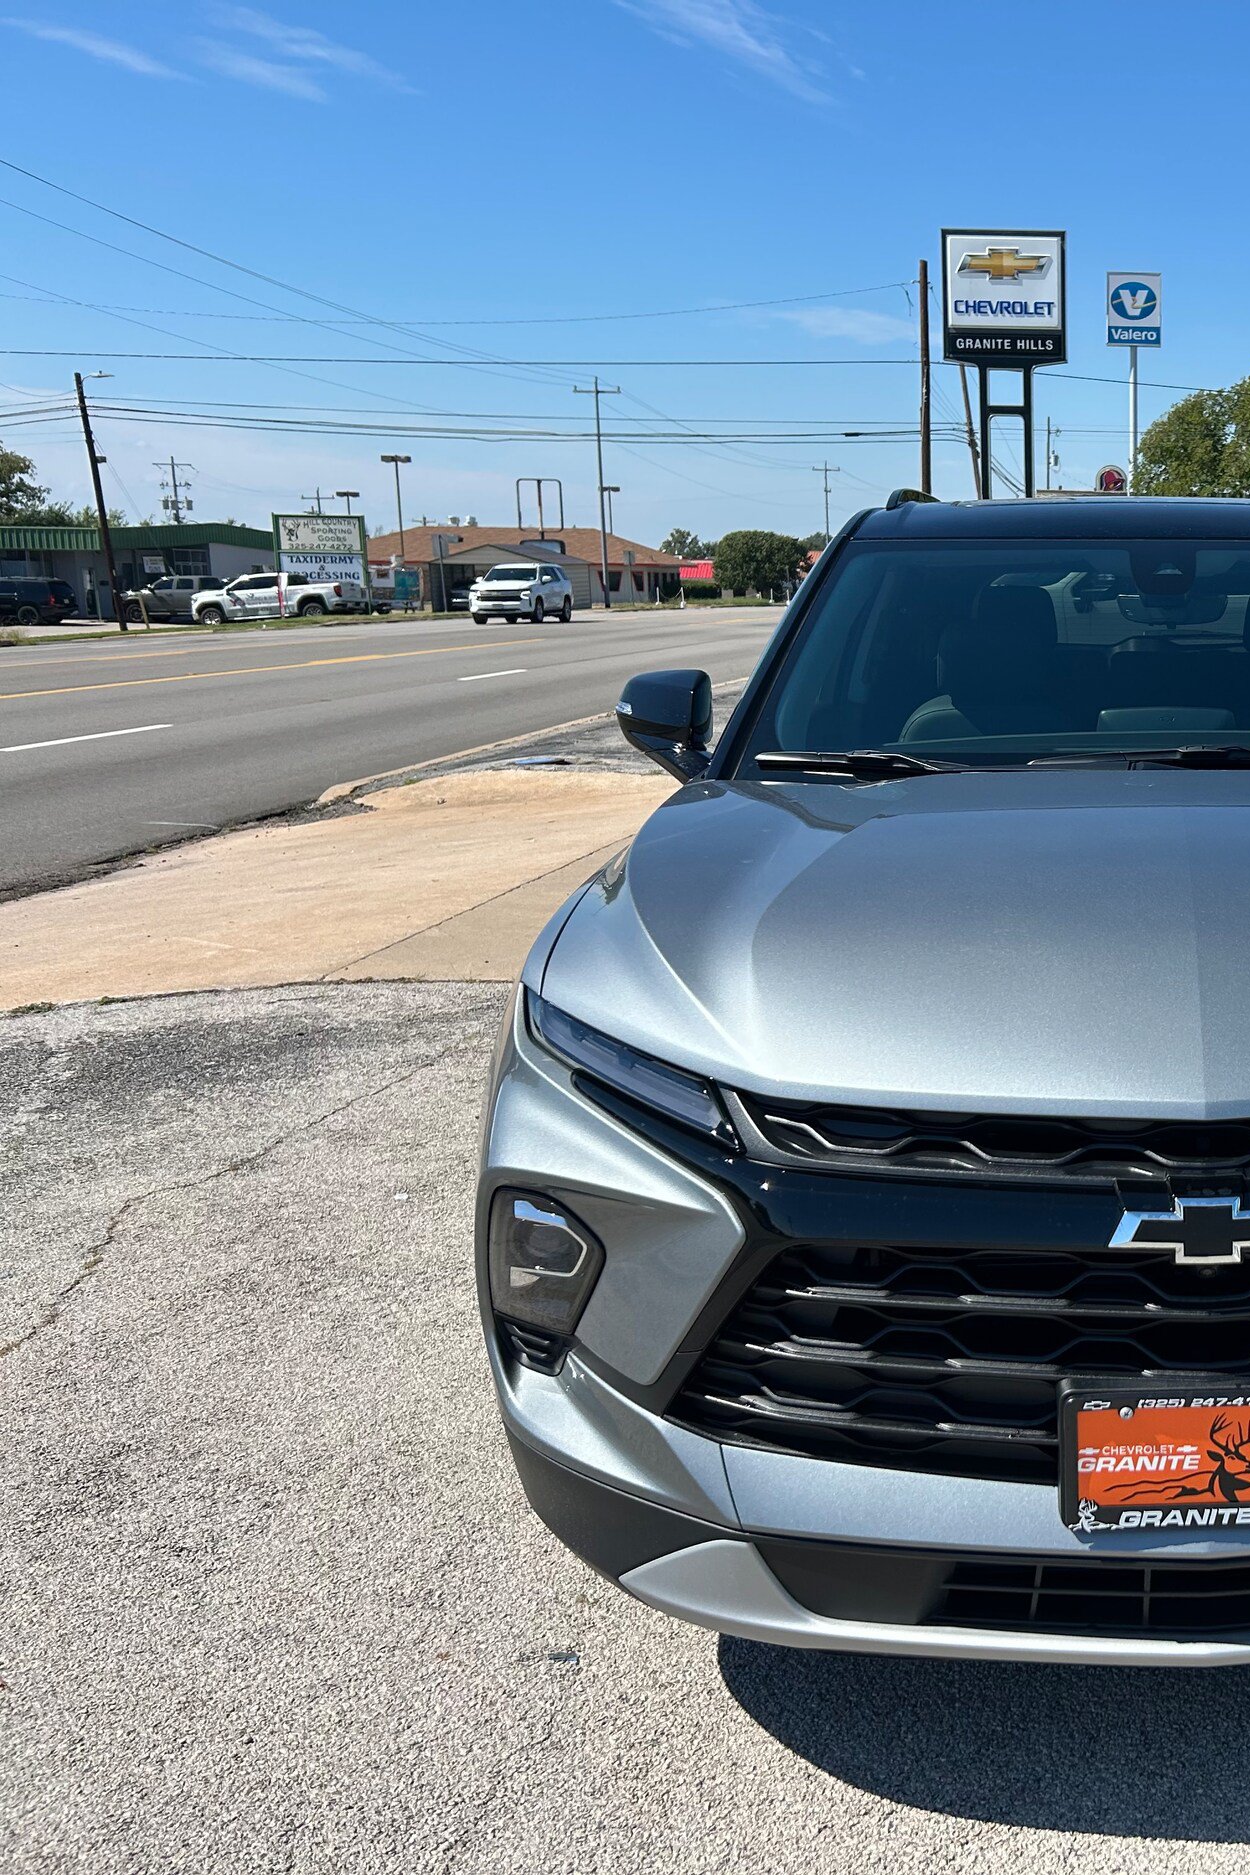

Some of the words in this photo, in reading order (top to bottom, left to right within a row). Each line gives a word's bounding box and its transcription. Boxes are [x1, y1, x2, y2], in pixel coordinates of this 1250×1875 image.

[953, 299, 1055, 317] CHEVROLET
[1111, 328, 1157, 342] Valero
[955, 338, 1012, 350] GRANITE
[1016, 339, 1054, 351] HILLS
[303, 519, 320, 529] HILL
[322, 518, 357, 529] COUNTRY
[310, 526, 353, 535] SPORTING
[317, 534, 348, 542] GOODS
[288, 543, 354, 551] 325-247-4272
[287, 555, 355, 564] TAXIDERMY
[1137, 1398, 1186, 1409] (325)
[1102, 1444, 1175, 1456] CHEVROLET
[1077, 1454, 1202, 1473] GRANITE
